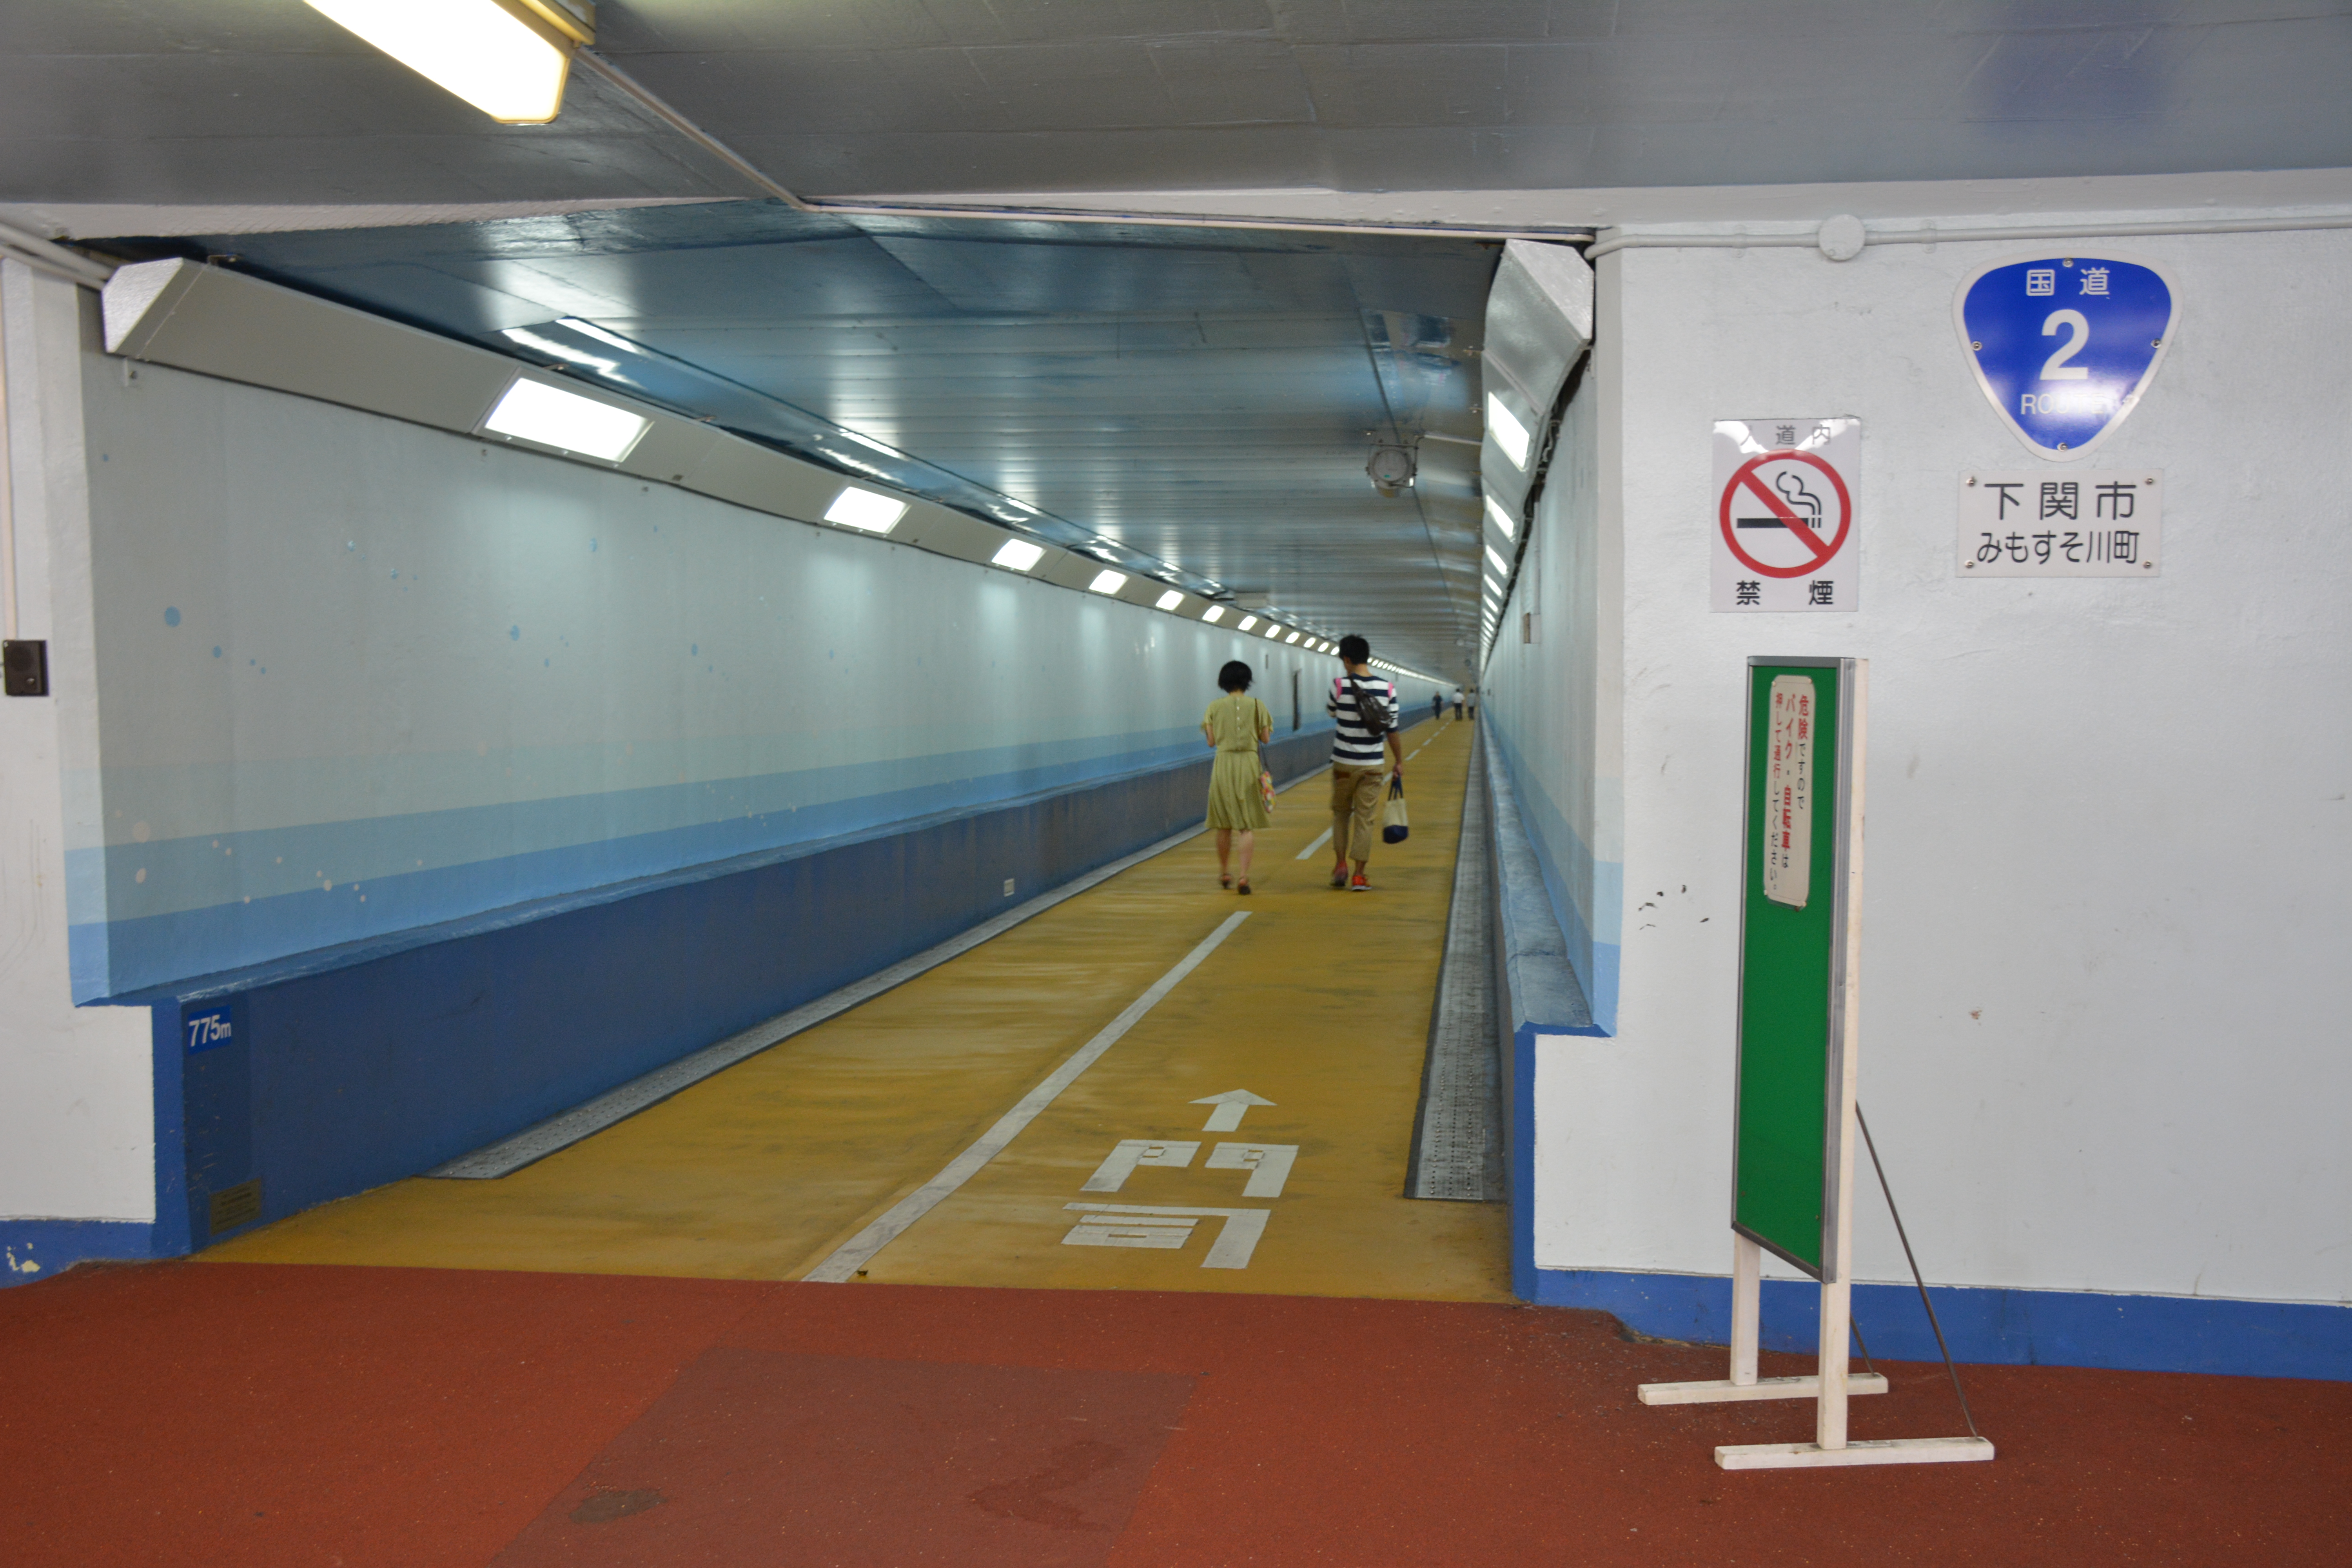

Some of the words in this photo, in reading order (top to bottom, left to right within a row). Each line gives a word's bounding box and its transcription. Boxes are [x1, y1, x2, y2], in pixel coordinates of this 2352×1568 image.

[2026, 267, 2110, 296] 国道
[2039, 309, 2089, 380] 2
[2021, 393, 2104, 414] ROUTE
[1984, 481, 2137, 520] 下関市
[1977, 530, 2140, 564] みもすそ川町
[1735, 580, 1834, 605] 禁煙
[1797, 694, 1809, 809] 危険ですので
[189, 1014, 232, 1047] 775m
[1061, 1139, 1299, 1270] 門司
